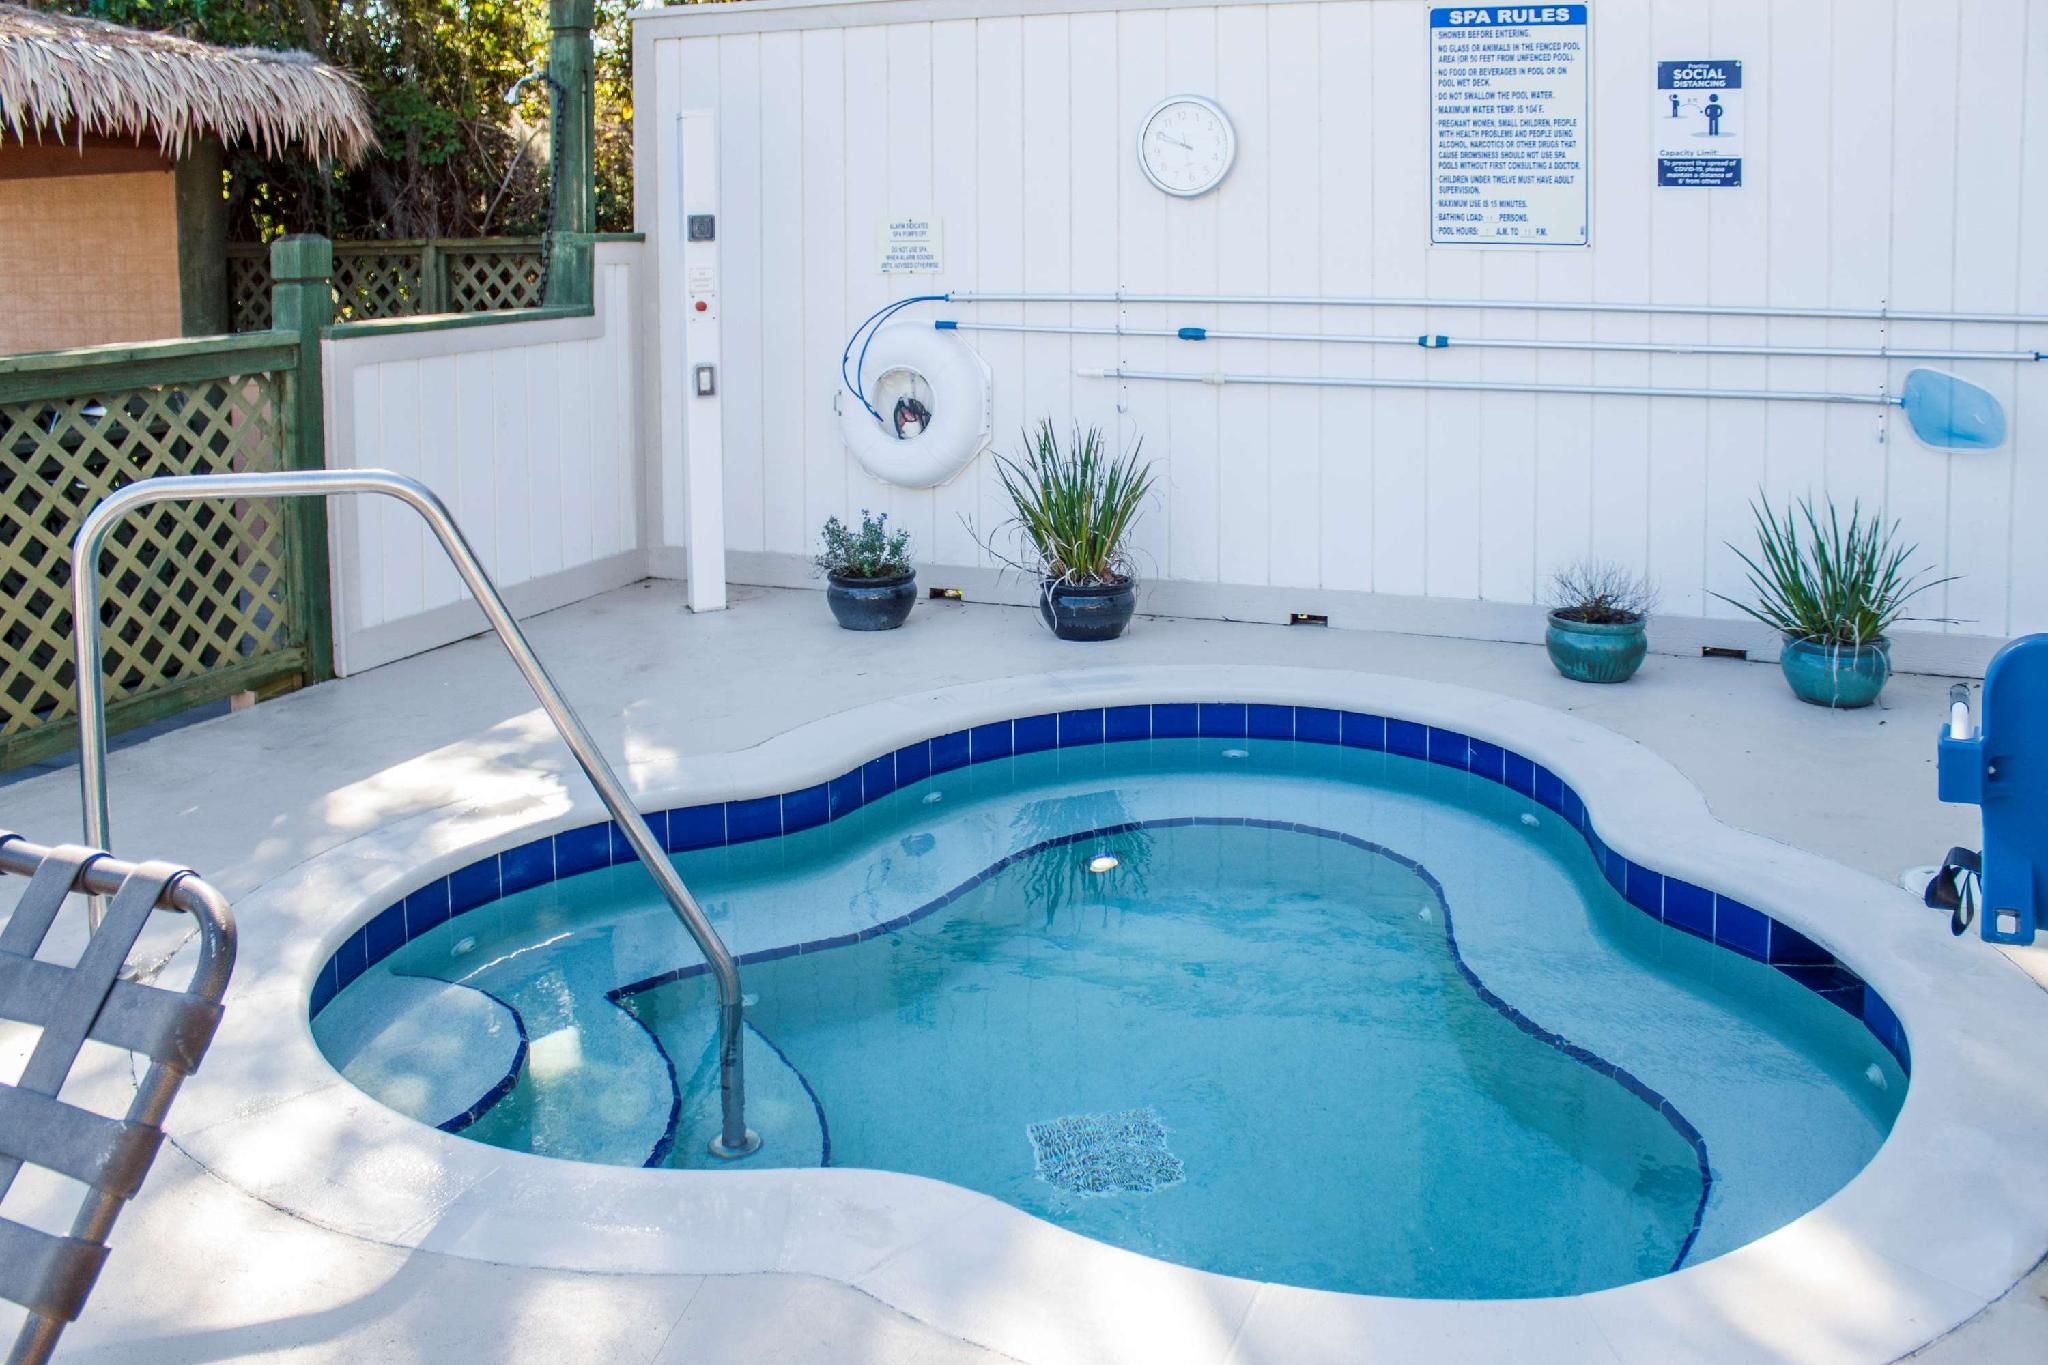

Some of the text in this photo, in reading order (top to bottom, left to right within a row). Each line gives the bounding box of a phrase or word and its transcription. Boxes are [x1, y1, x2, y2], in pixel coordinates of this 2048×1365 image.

[1449, 8, 1570, 25] SPA RULES
[1517, 53, 1551, 61] UNFENCED
[1673, 68, 1726, 80] SOCIAL
[1554, 176, 1574, 184] ADULT
